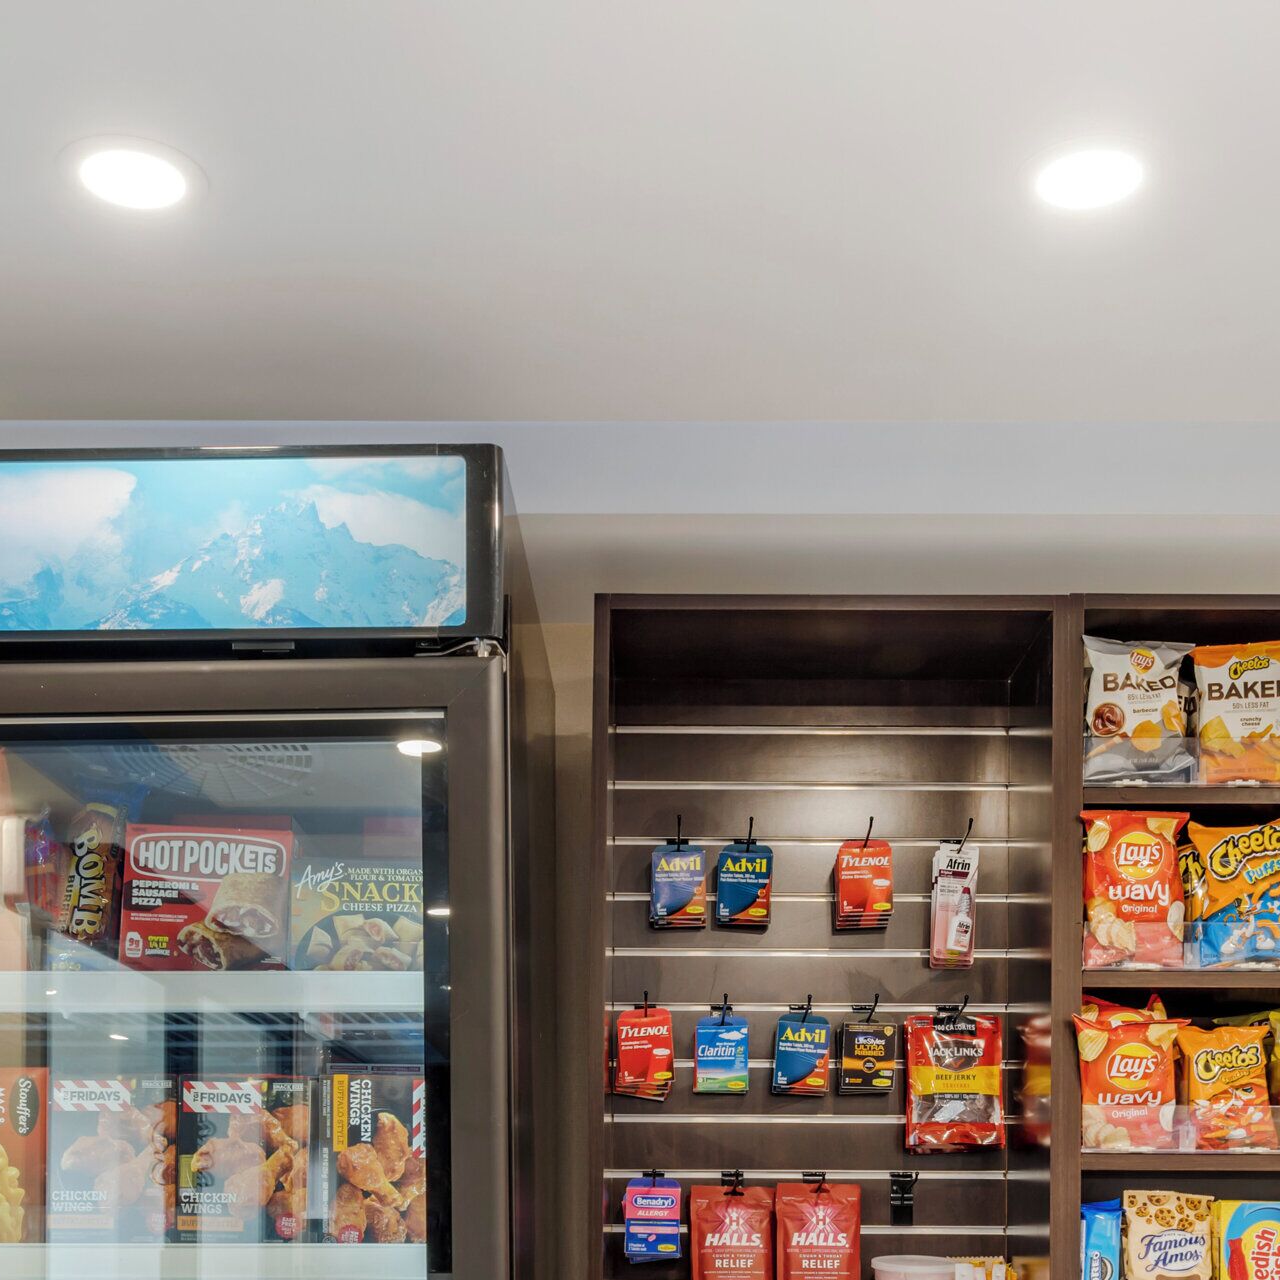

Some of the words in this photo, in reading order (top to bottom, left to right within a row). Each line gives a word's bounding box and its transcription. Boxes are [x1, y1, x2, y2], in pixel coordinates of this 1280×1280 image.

[1228, 656, 1270, 680] Cheetos
[1103, 673, 1177, 693] BAKED
[139, 841, 183, 868] HOT
[183, 841, 277, 874] POCKETS
[840, 855, 890, 868] TYLENOL
[1118, 842, 1160, 868] Lay's
[655, 855, 701, 872] Advil
[722, 856, 767, 874] Advil
[946, 858, 971, 871] Afrin
[132, 881, 191, 890] PEPPERONI
[294, 862, 343, 898] Amy's
[132, 890, 178, 898] SAUSAGE
[1108, 881, 1169, 905] wavy
[343, 903, 383, 912] CHEESE
[386, 904, 417, 913] PIZZA
[1122, 904, 1158, 914] Original
[620, 1026, 669, 1039] TYLENOL
[780, 1027, 826, 1043] Advil
[698, 1044, 735, 1057] Claritin
[1110, 1055, 1159, 1080] Lay's
[1194, 1045, 1260, 1083] Cheetos
[350, 1079, 360, 1125] WINGS
[1098, 1090, 1162, 1106] wavy
[18, 1078, 33, 1134] Stouffer's
[361, 1079, 371, 1142] CHICKEN
[1111, 1107, 1148, 1119] Original
[52, 1190, 107, 1201] CHICKEN
[181, 1192, 237, 1203] CHICKEN
[636, 1197, 673, 1207] Benadryl
[52, 1202, 93, 1212] WINGS
[181, 1204, 221, 1214] WINGS
[705, 1233, 761, 1247] HALLS
[791, 1233, 848, 1247] HALLS
[1138, 1233, 1206, 1260] Famous
[715, 1259, 754, 1268] RELIEF
[802, 1260, 840, 1269] RELIEF
[1145, 1252, 1199, 1273] Amos
